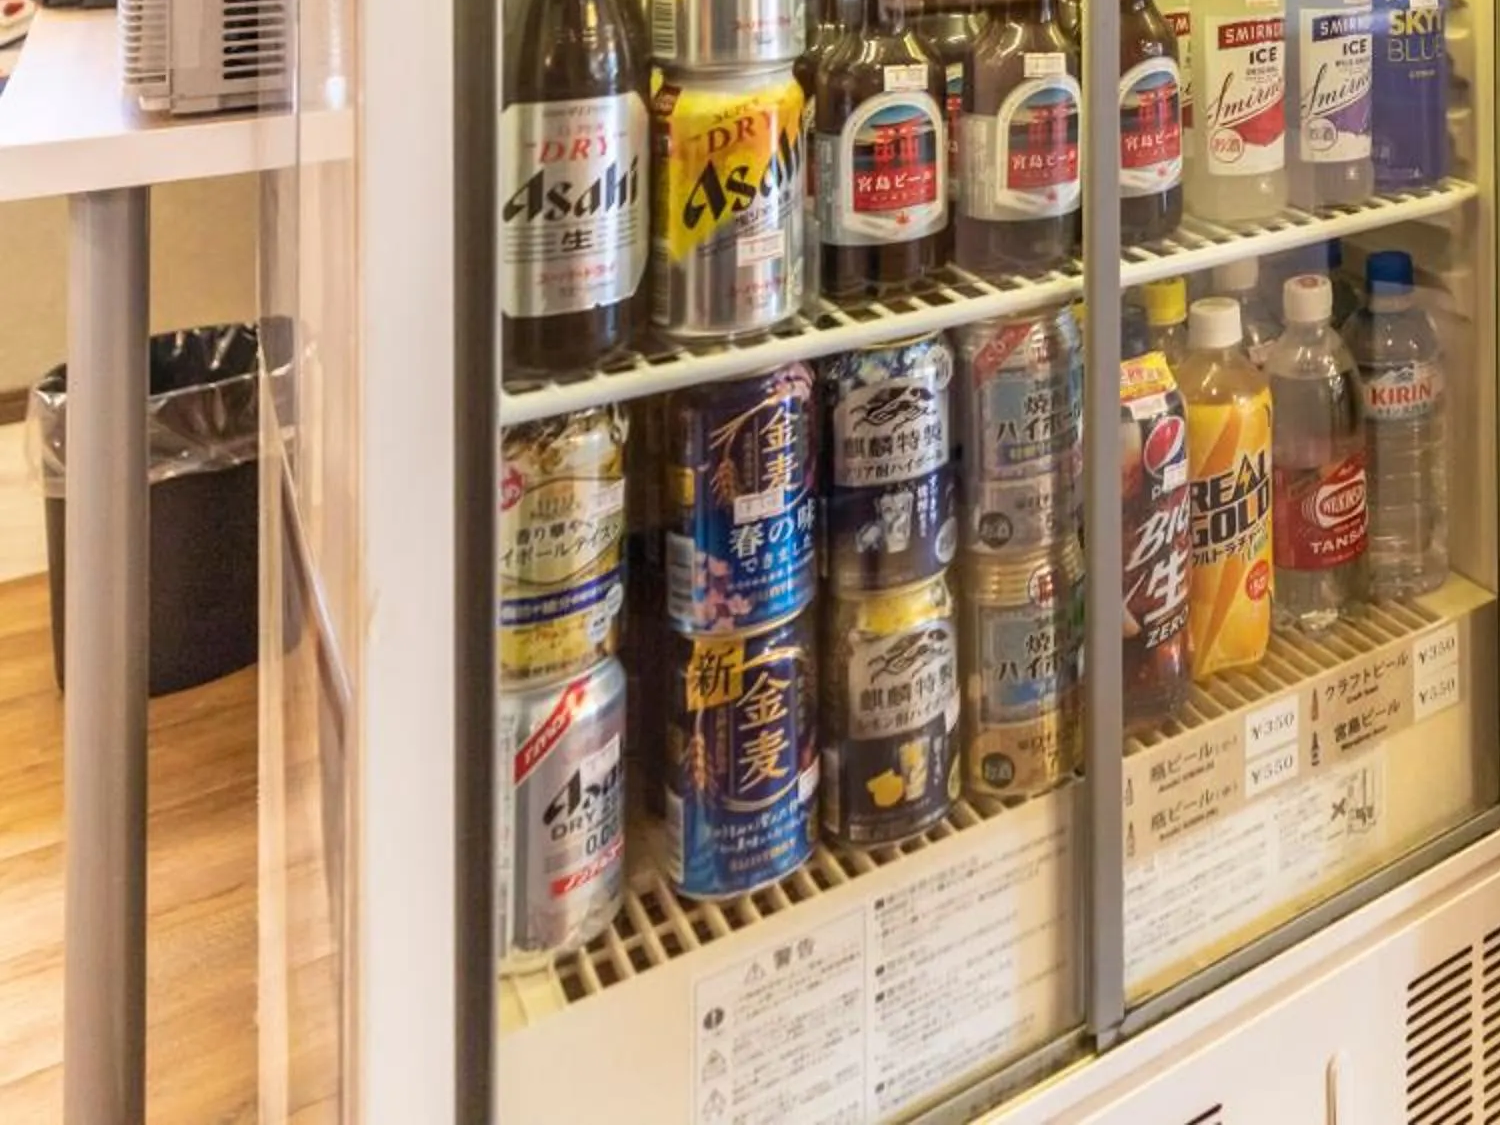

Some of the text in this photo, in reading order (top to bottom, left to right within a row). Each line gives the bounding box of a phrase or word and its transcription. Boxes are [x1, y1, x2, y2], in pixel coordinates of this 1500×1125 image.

[1249, 46, 1277, 64] ICE
[1342, 39, 1368, 56] ICE
[540, 136, 608, 164] DRY
[707, 113, 772, 155] DRY
[503, 155, 639, 224] Asahi
[560, 229, 593, 253] 生
[1371, 382, 1433, 406] KIRIN
[1189, 449, 1269, 513] REAL
[694, 647, 736, 698] 新
[1324, 651, 1409, 701] クラフトビール
[736, 671, 793, 794] 金麦
[1251, 712, 1295, 740] ¥350
